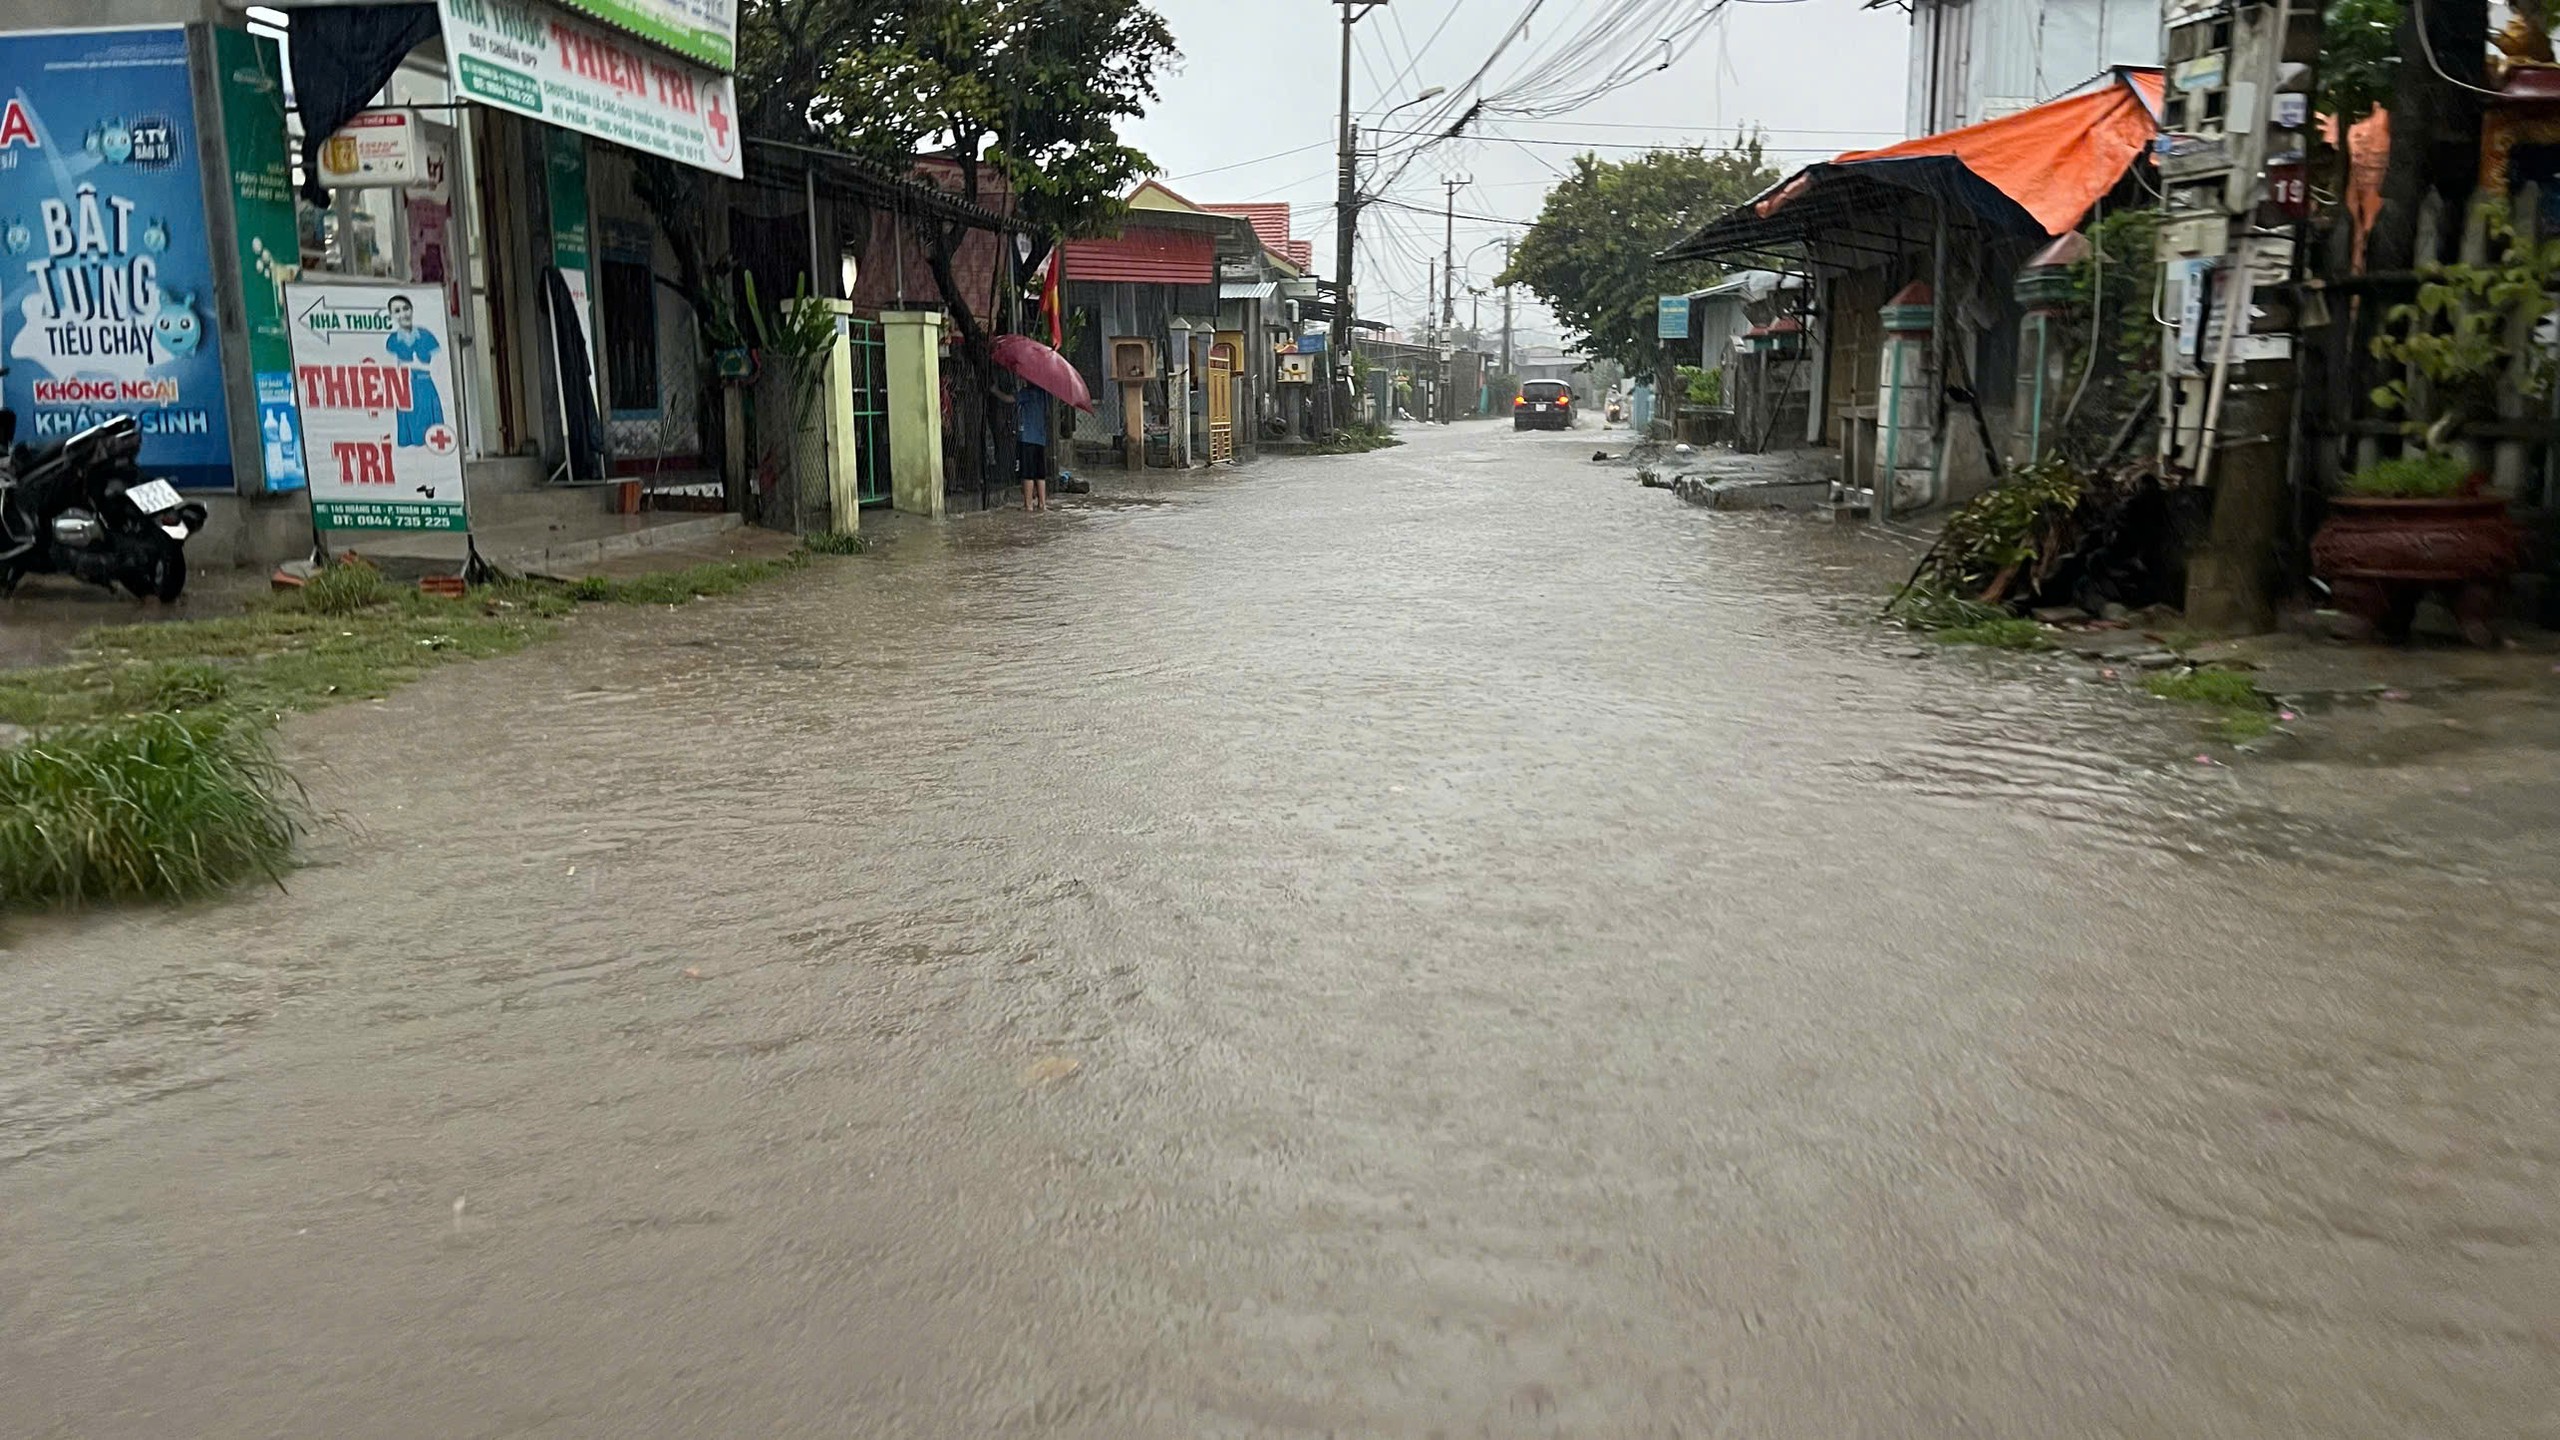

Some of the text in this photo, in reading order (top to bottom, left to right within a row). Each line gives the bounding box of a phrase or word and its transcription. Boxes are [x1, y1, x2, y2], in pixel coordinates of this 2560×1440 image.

[551, 20, 648, 97] THIỆN
[650, 62, 697, 116] TRÍ
[2274, 179, 2304, 203] 19
[41, 182, 135, 264] BẬT
[310, 310, 340, 330] NHÀ
[345, 309, 393, 330] THUỐC
[45, 317, 154, 364] TIÊU CHẢY
[35, 376, 179, 407] KHÔNG NGẠI
[299, 357, 412, 418] THIỆN
[142, 409, 208, 434] SINH
[333, 433, 396, 485] TRÍ
[357, 515, 392, 528] 0944
[395, 516, 421, 528] 735
[424, 517, 451, 529] 225
